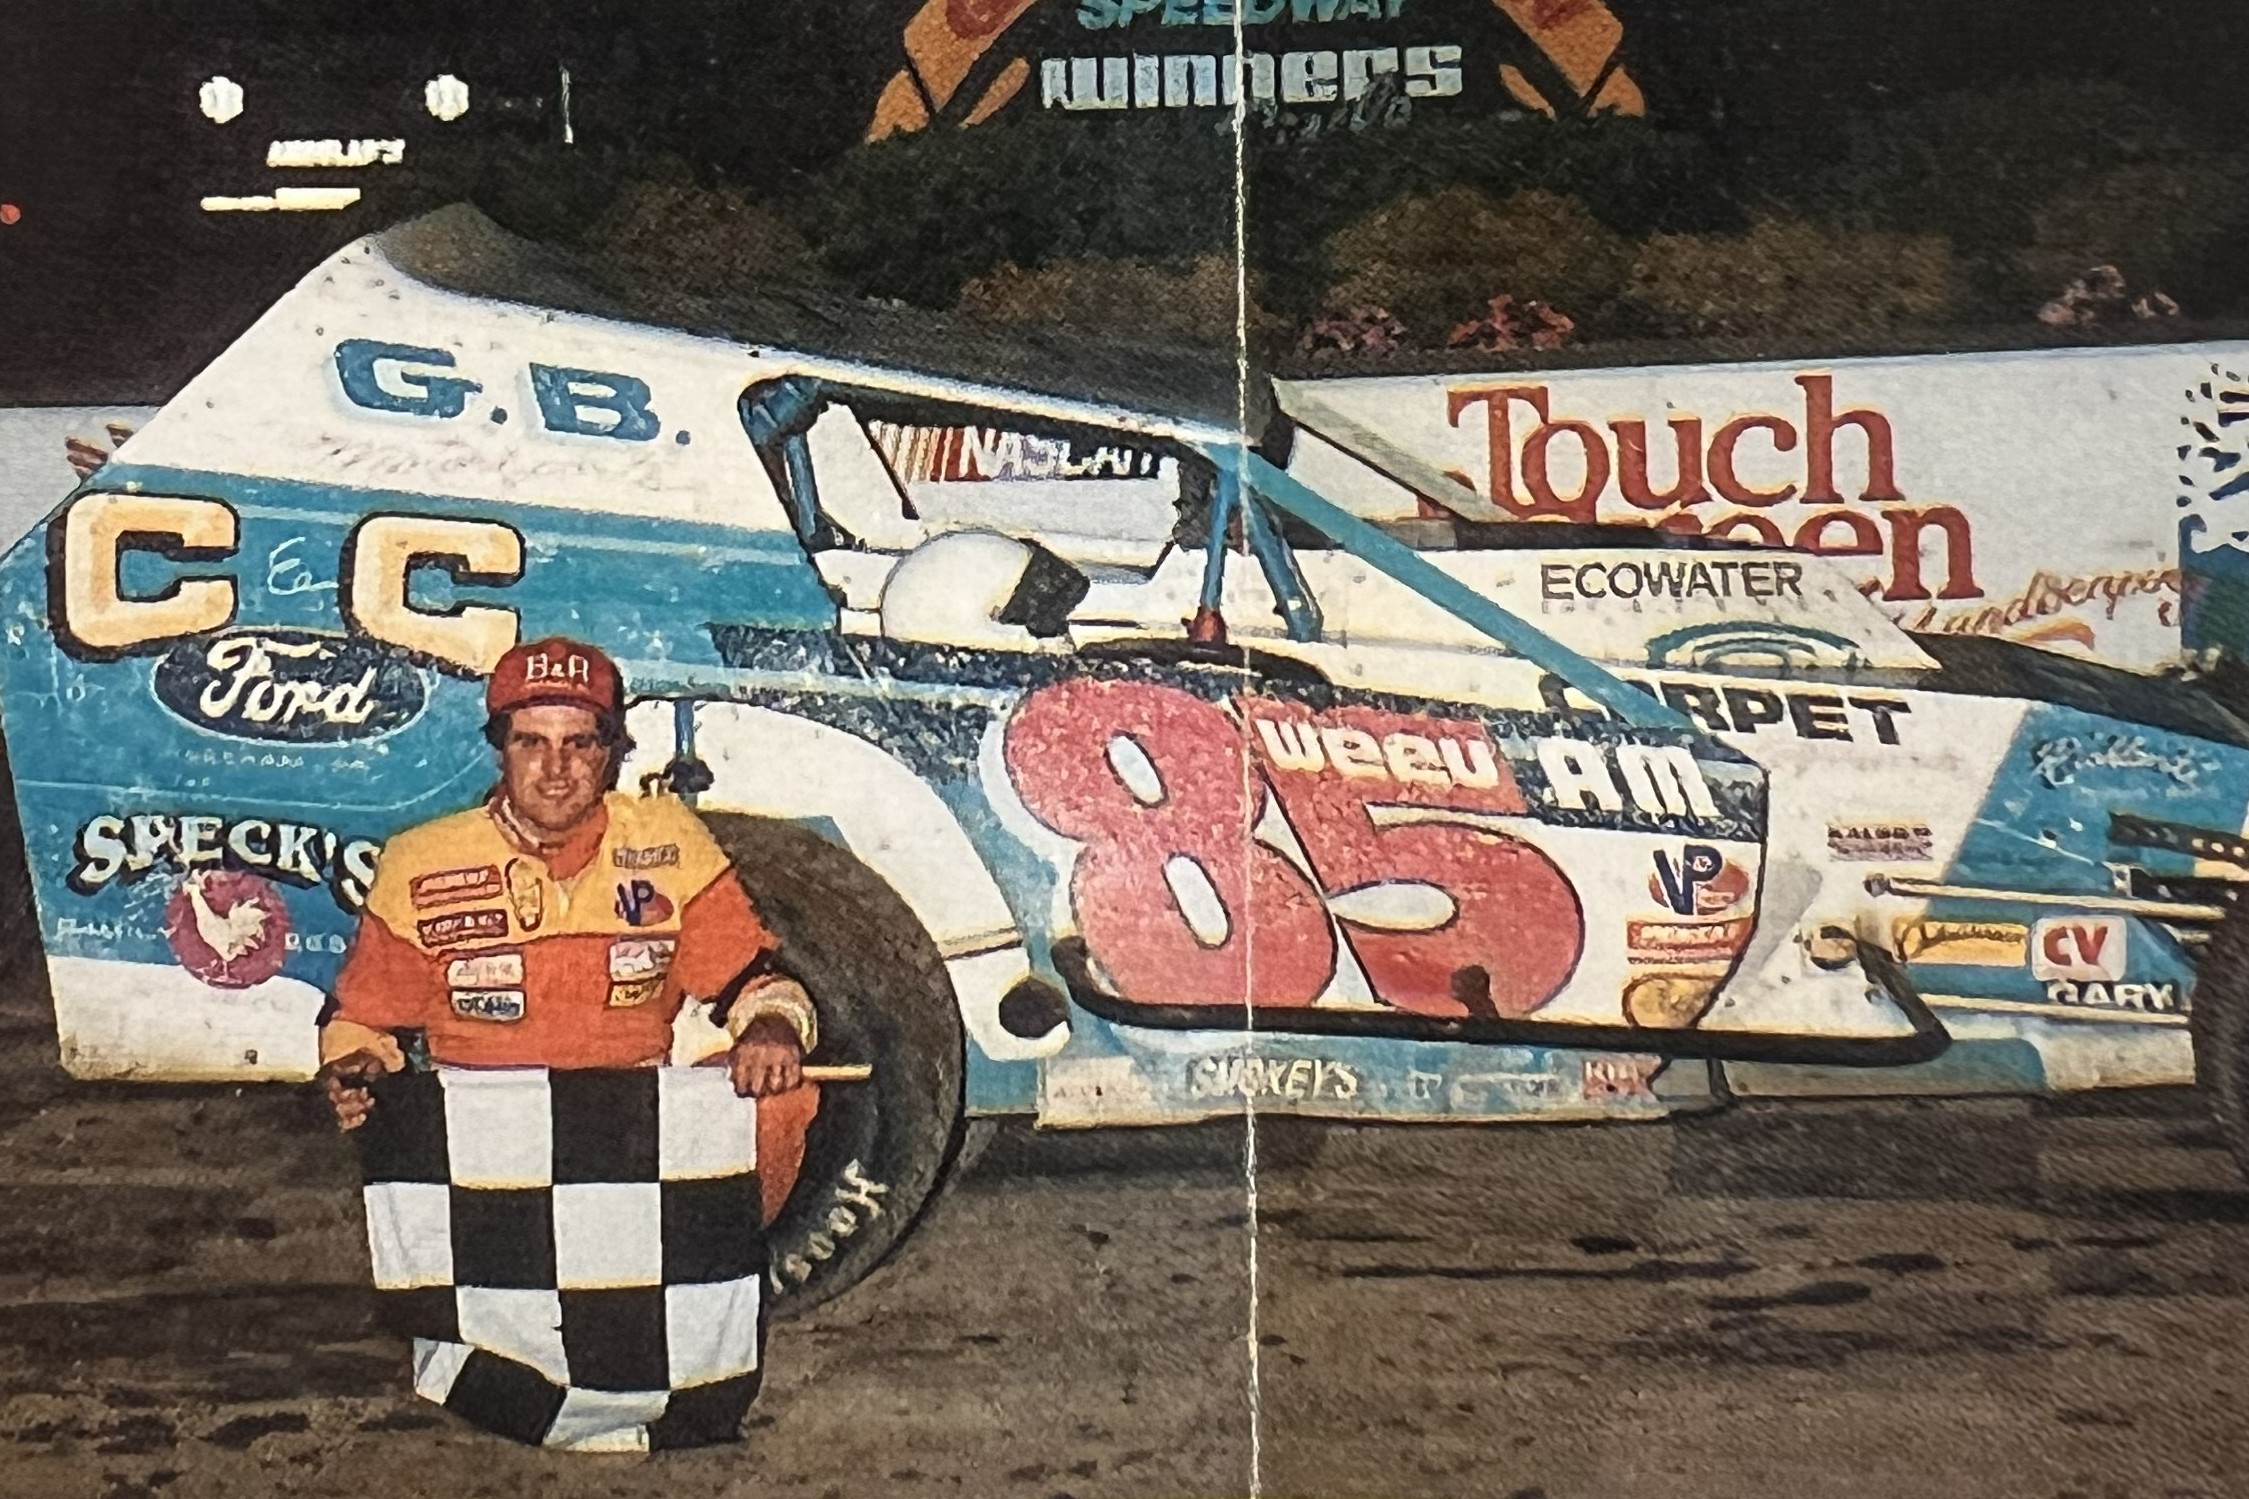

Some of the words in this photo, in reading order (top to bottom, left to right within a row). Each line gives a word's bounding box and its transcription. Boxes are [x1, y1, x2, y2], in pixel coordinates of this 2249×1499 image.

[1447, 374, 1905, 510] Touch
[48, 489, 240, 662] C
[337, 511, 526, 681] C
[1541, 562, 1804, 600] ECOWATER
[200, 637, 379, 724] Ford
[1538, 671, 1912, 745] CRPET
[1003, 677, 1583, 1018] 85
[1653, 844, 1723, 916] VP
[616, 878, 656, 927] VP
[2043, 924, 2109, 967] CV
